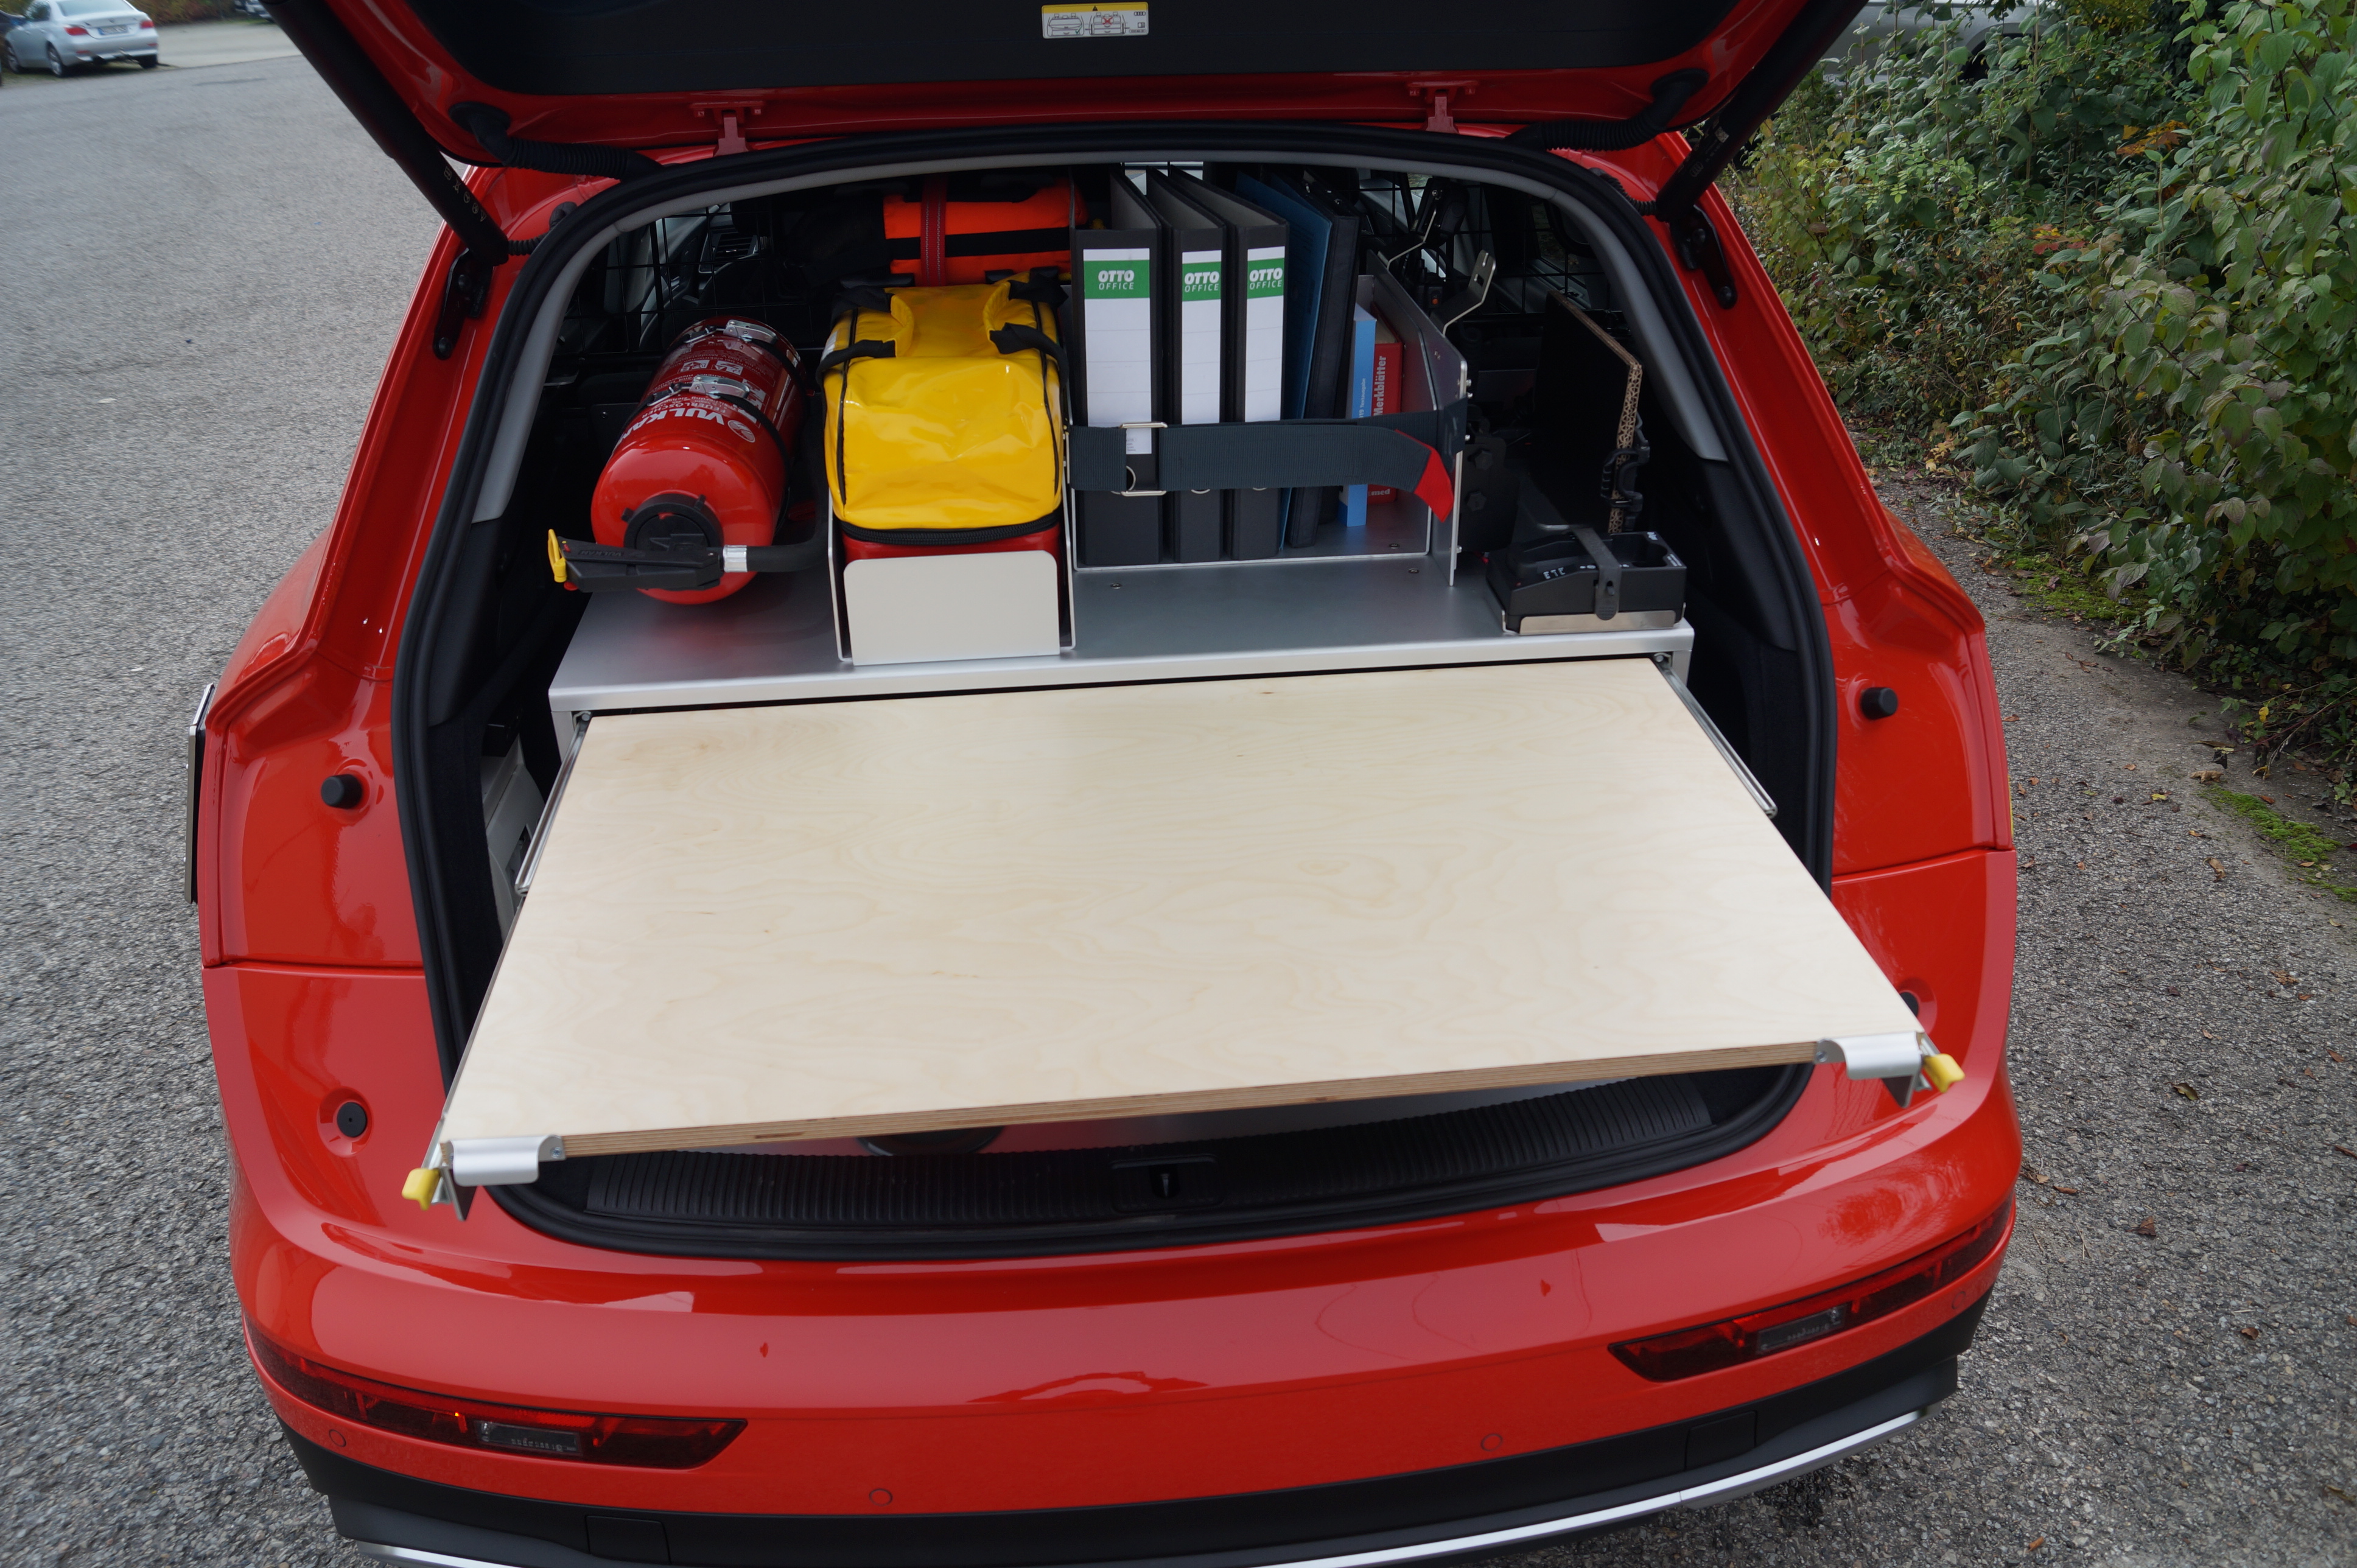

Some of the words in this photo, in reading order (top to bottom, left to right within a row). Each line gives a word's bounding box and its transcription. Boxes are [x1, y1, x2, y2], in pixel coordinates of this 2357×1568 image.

[1098, 270, 1135, 282] OTTO
[1185, 271, 1220, 285] OTTO
[1249, 267, 1283, 282] OTTO
[1099, 282, 1135, 290] OFFICE
[1185, 283, 1219, 293] OFFICE
[1249, 280, 1283, 290] OFFICE
[1373, 355, 1387, 416] Merkblätter
[642, 402, 726, 418] FEUERLÖSCHER
[620, 408, 724, 441] VULKAN
